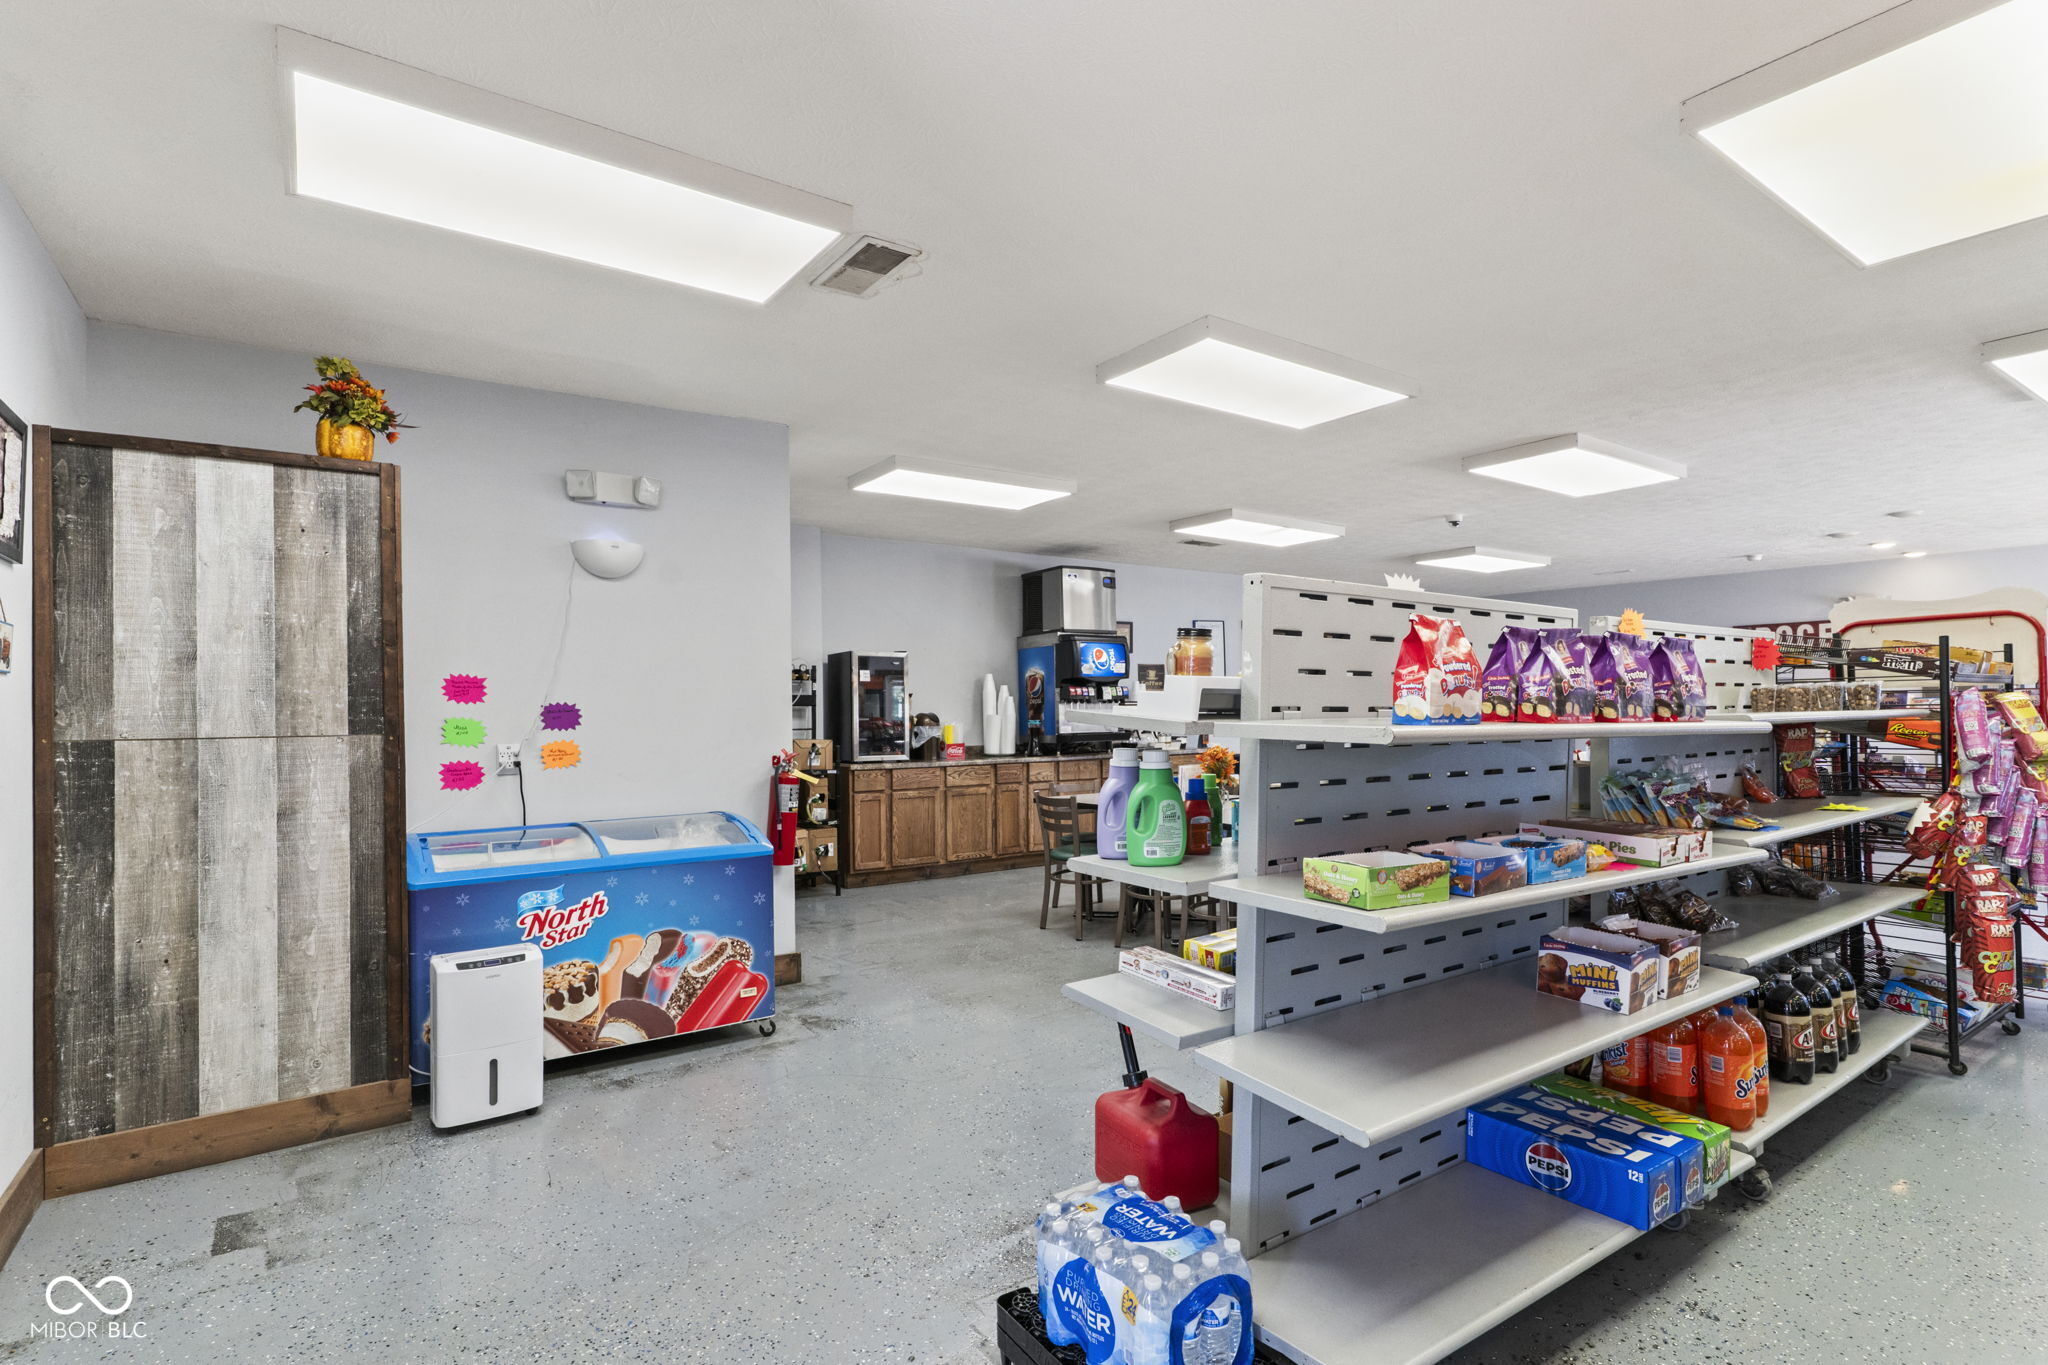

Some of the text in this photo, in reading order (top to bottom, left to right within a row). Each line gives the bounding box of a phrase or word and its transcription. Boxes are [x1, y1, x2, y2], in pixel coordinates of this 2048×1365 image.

[1442, 661, 1472, 672] owdered
[1608, 841, 1637, 855] Pies
[1972, 871, 1995, 886] RAP
[519, 893, 606, 938] North
[542, 922, 590, 947] Star
[1571, 978, 1617, 989] MUFFINS
[1523, 1091, 1685, 1149] PEPSI
[1485, 1102, 1653, 1163] PEPSI
[1528, 1156, 1569, 1178] PEPSI
[1627, 1169, 1639, 1182] 12
[1115, 1203, 1177, 1239] WATER
